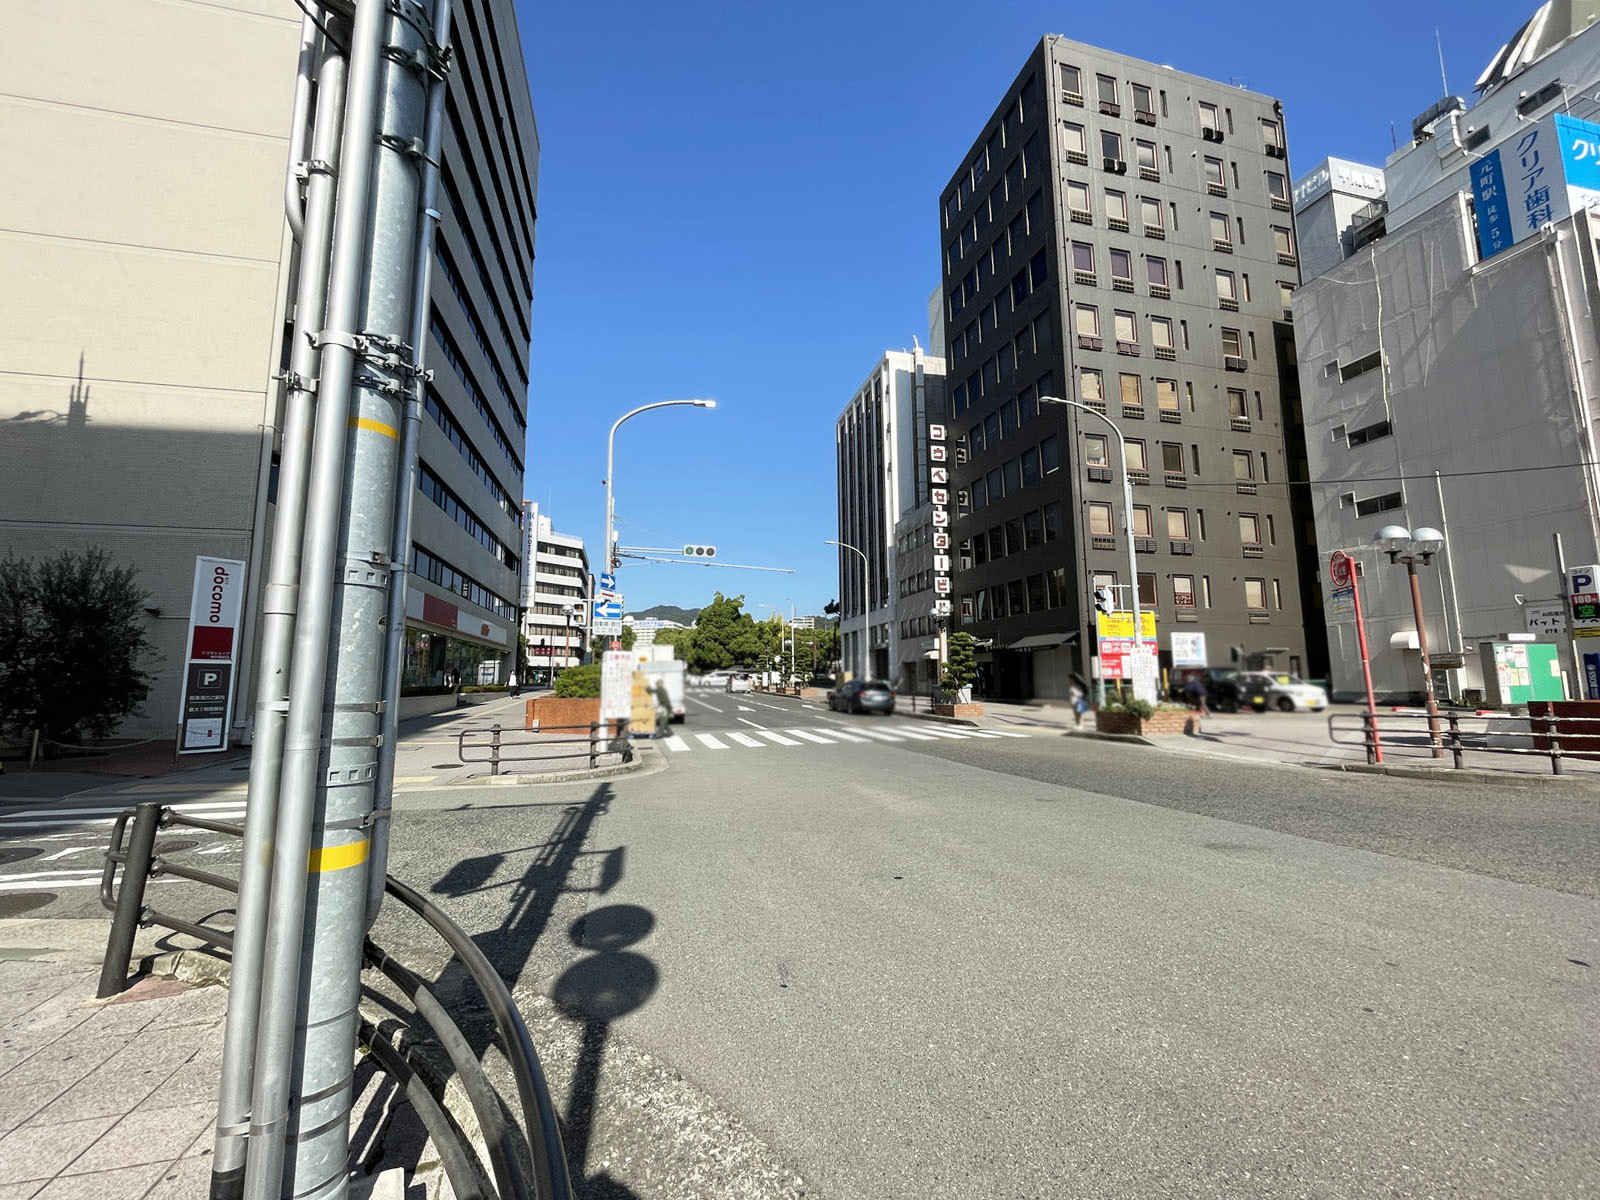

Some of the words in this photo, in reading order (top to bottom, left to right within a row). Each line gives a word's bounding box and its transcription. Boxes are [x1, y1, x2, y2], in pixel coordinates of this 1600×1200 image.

[1479, 160, 1498, 202] 元町駅
[1517, 131, 1554, 230] クリア歯科
[209, 566, 229, 623] docomo
[1572, 575, 1592, 593] P
[204, 672, 217, 686] P
